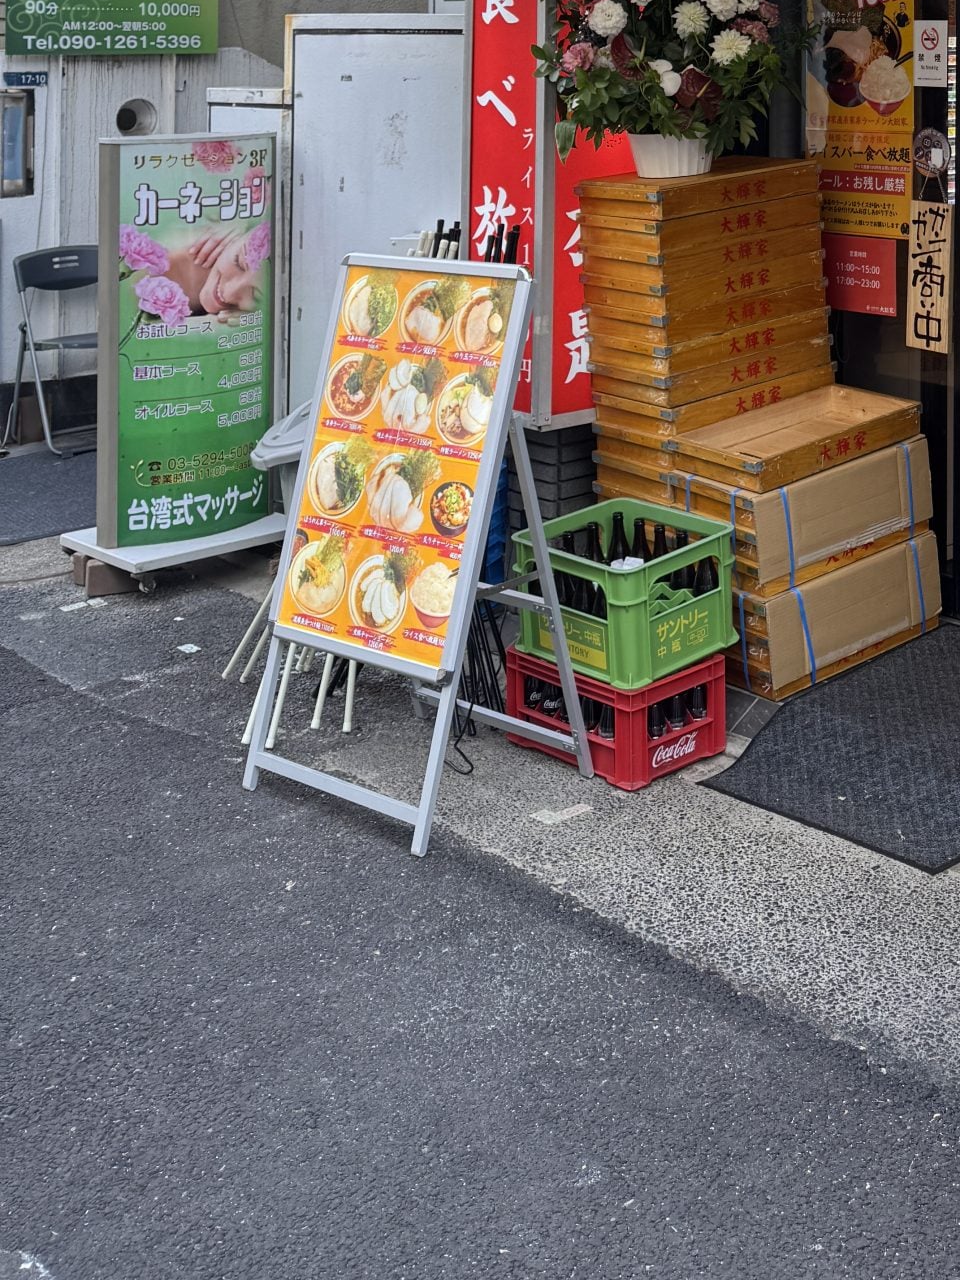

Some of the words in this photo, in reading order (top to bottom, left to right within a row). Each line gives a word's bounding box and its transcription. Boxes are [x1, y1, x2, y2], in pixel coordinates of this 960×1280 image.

[25, 0, 59, 15] 90分
[138, 2, 201, 17] 10,000円
[22, 34, 202, 51] Tel.090-1261-5396
[21, 75, 46, 85] 17-10
[134, 152, 248, 170] リラクゼーション
[250, 149, 268, 168] 3F
[808, 144, 911, 163] ライスバー食べ放題
[133, 175, 266, 226] カーネーション
[720, 209, 767, 234] 大輝家
[723, 268, 770, 294] 大輝家
[136, 320, 214, 339] お試しコース
[728, 327, 777, 355] 大輝家
[133, 363, 202, 381] 基本コース
[729, 355, 778, 384] 大輝家
[134, 400, 214, 420] オイルコース
[734, 385, 782, 415] 大輝家
[819, 431, 868, 462] 大輝家
[150, 471, 196, 487] 営業時間
[127, 474, 264, 532] 台湾式マッサージ
[656, 608, 708, 643] サントリー
